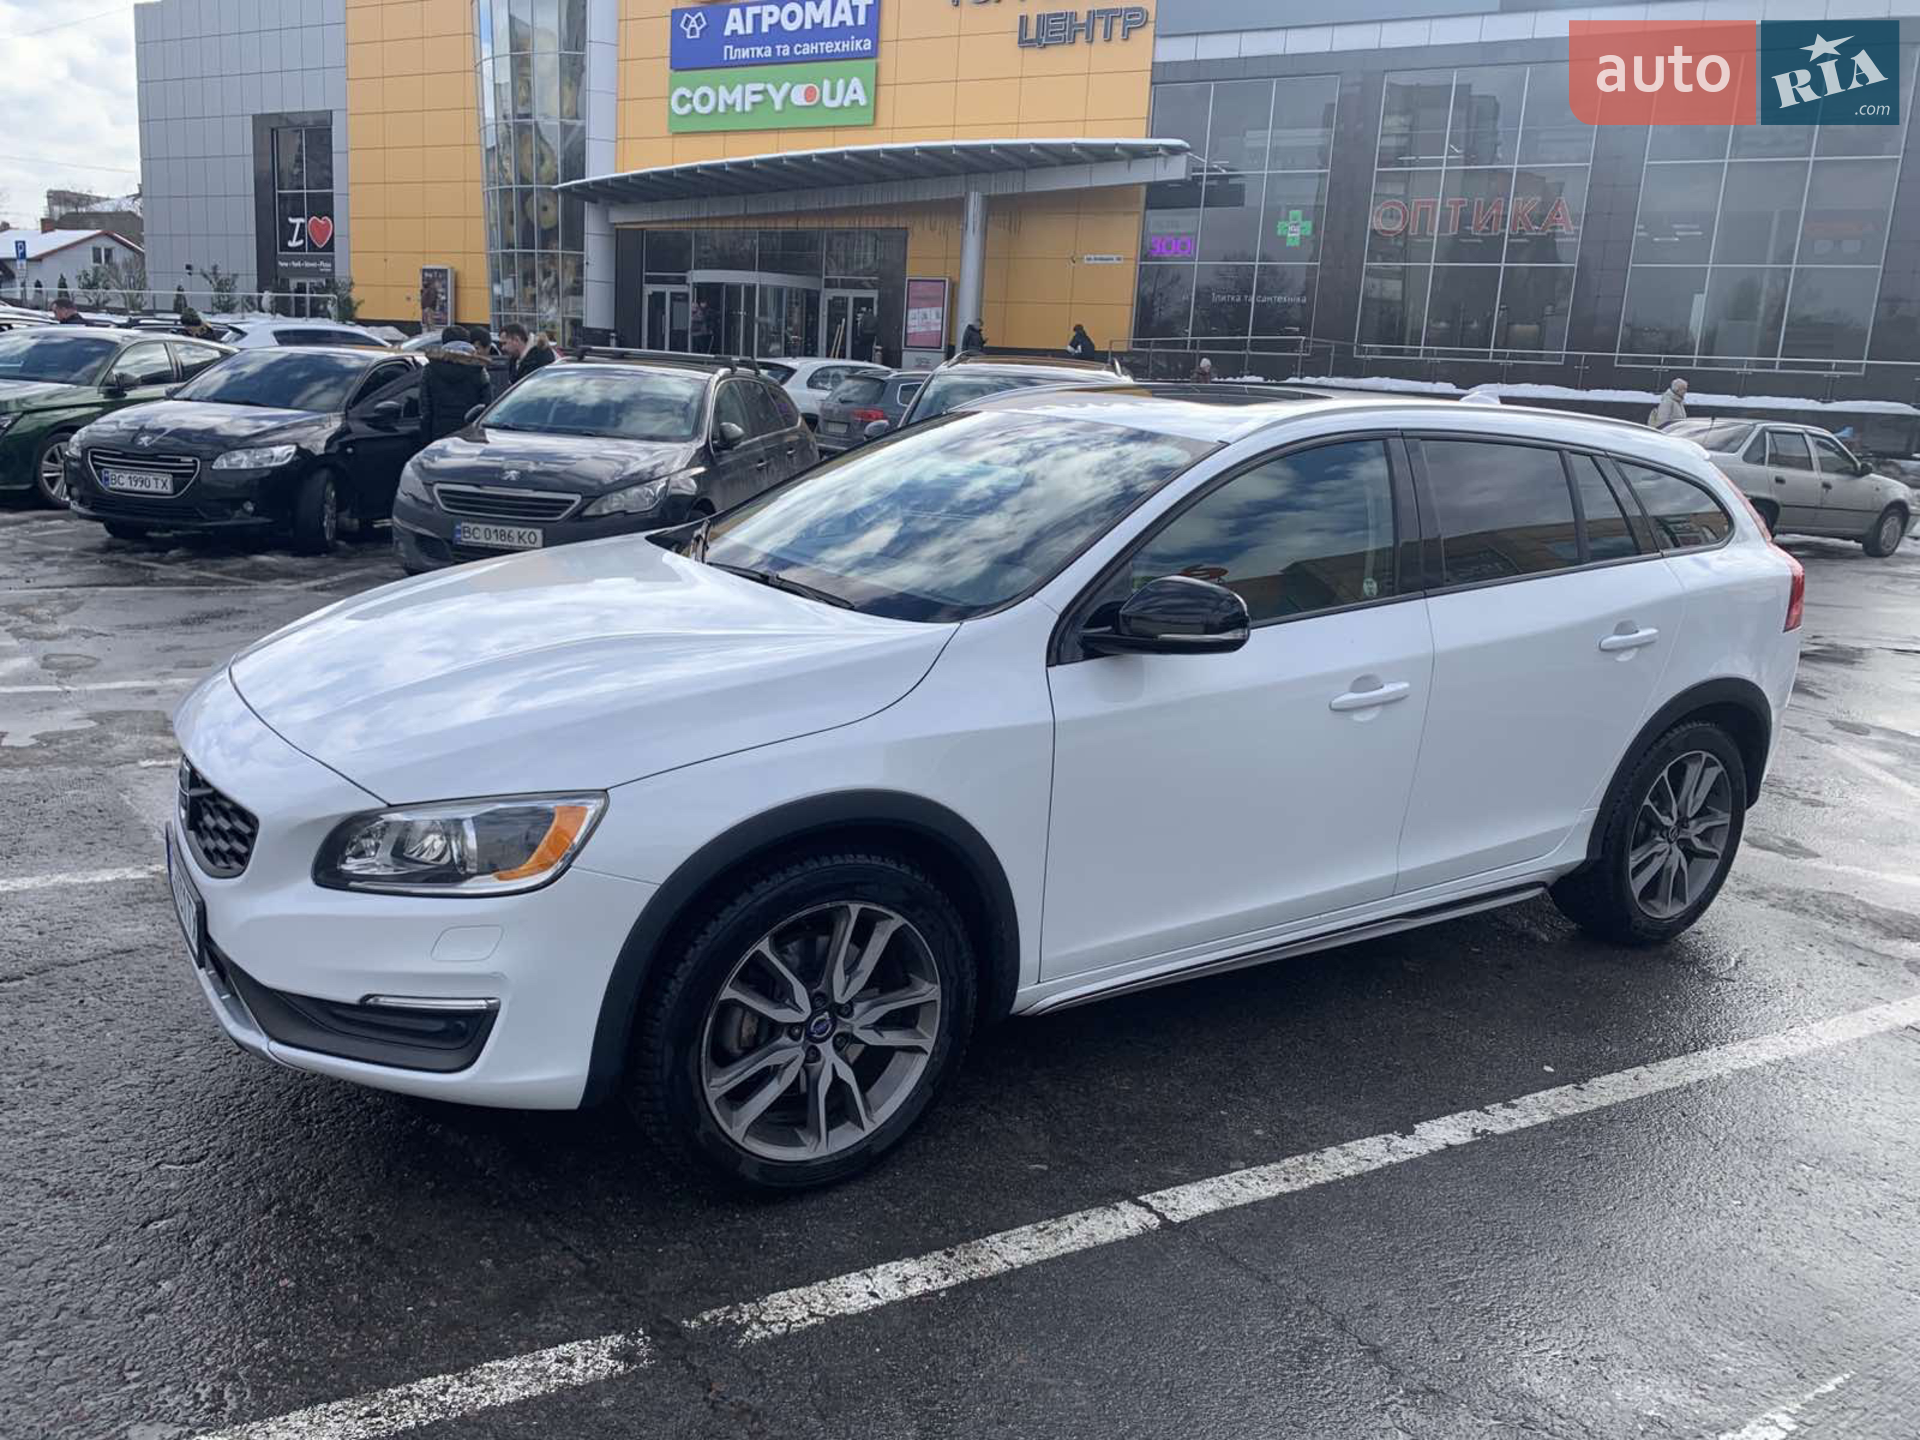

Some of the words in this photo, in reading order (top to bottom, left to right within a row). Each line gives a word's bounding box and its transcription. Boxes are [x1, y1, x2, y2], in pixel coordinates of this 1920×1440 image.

[724, 0, 873, 36] АГРОМАТ
[1018, 7, 1148, 47] ЦЕНТР
[724, 45, 772, 60] Плитка
[776, 43, 790, 57] та
[793, 36, 871, 56] сантехніка
[1373, 196, 1574, 236] ОПТИКА
